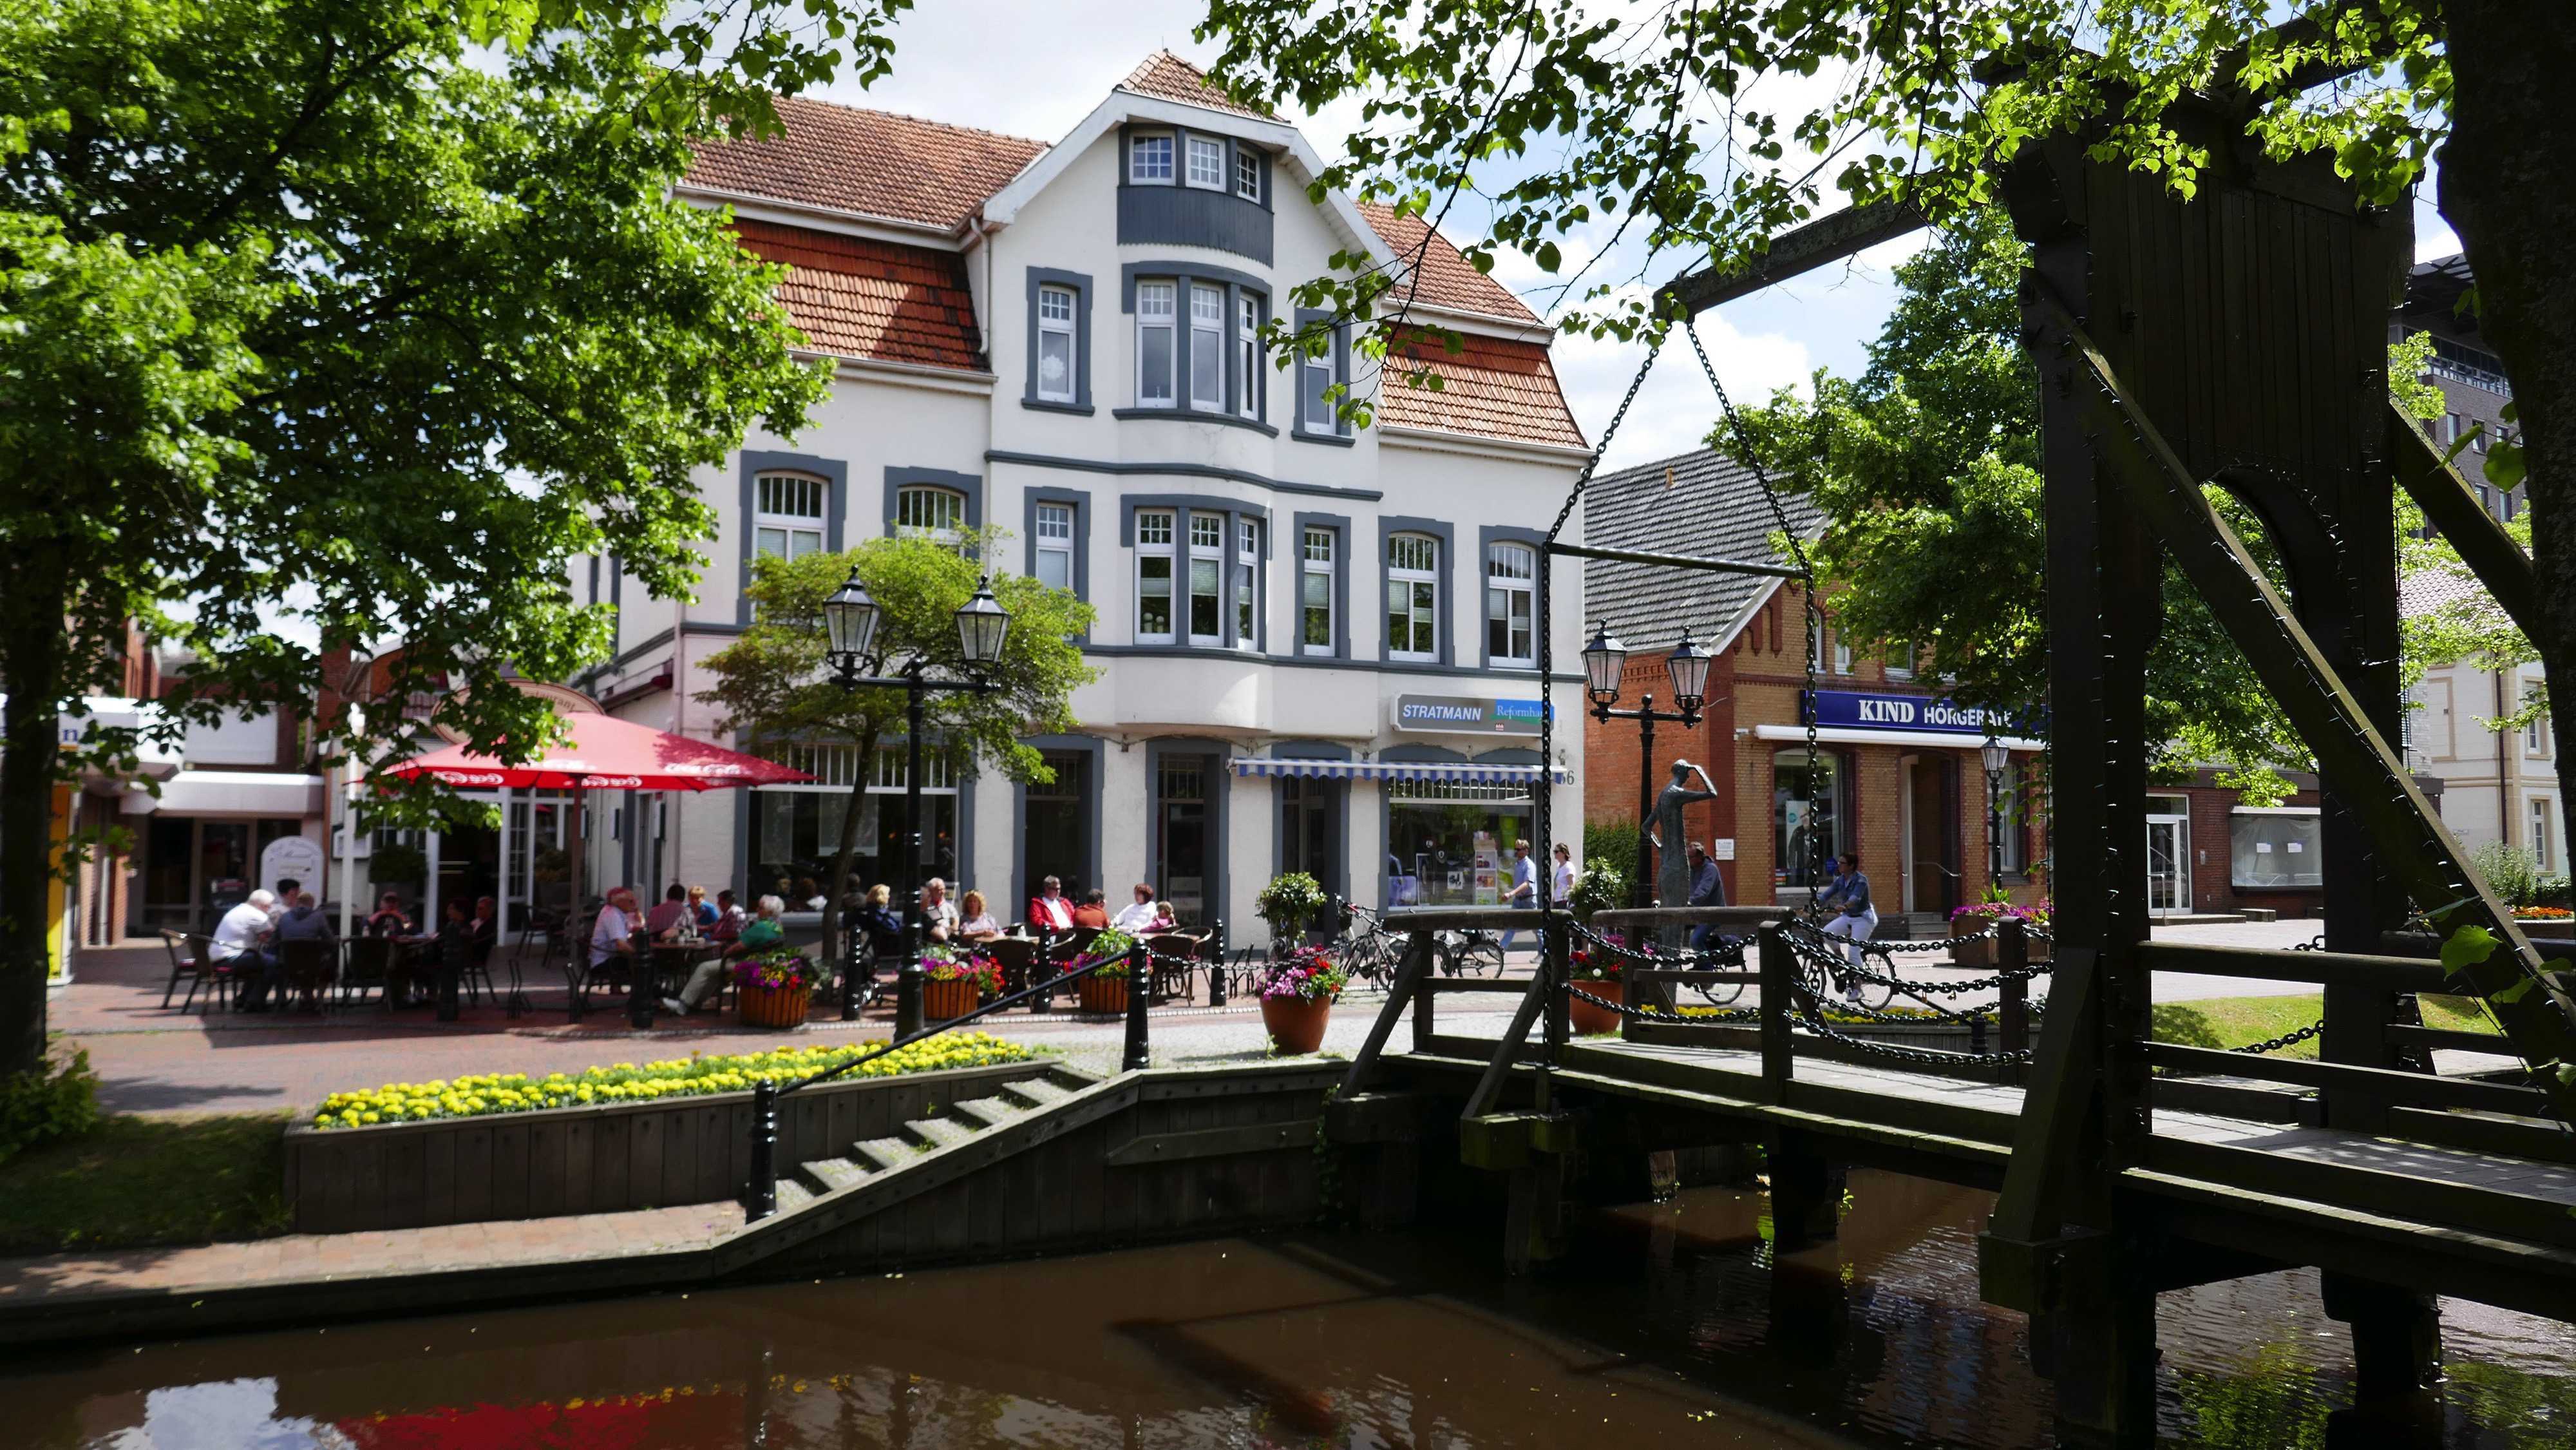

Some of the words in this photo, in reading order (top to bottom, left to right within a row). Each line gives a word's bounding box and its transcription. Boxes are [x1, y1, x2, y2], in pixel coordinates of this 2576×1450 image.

[1402, 704, 1482, 721] STRATMANN
[1497, 705, 1543, 720] Reformha
[1858, 700, 1915, 723] KIND
